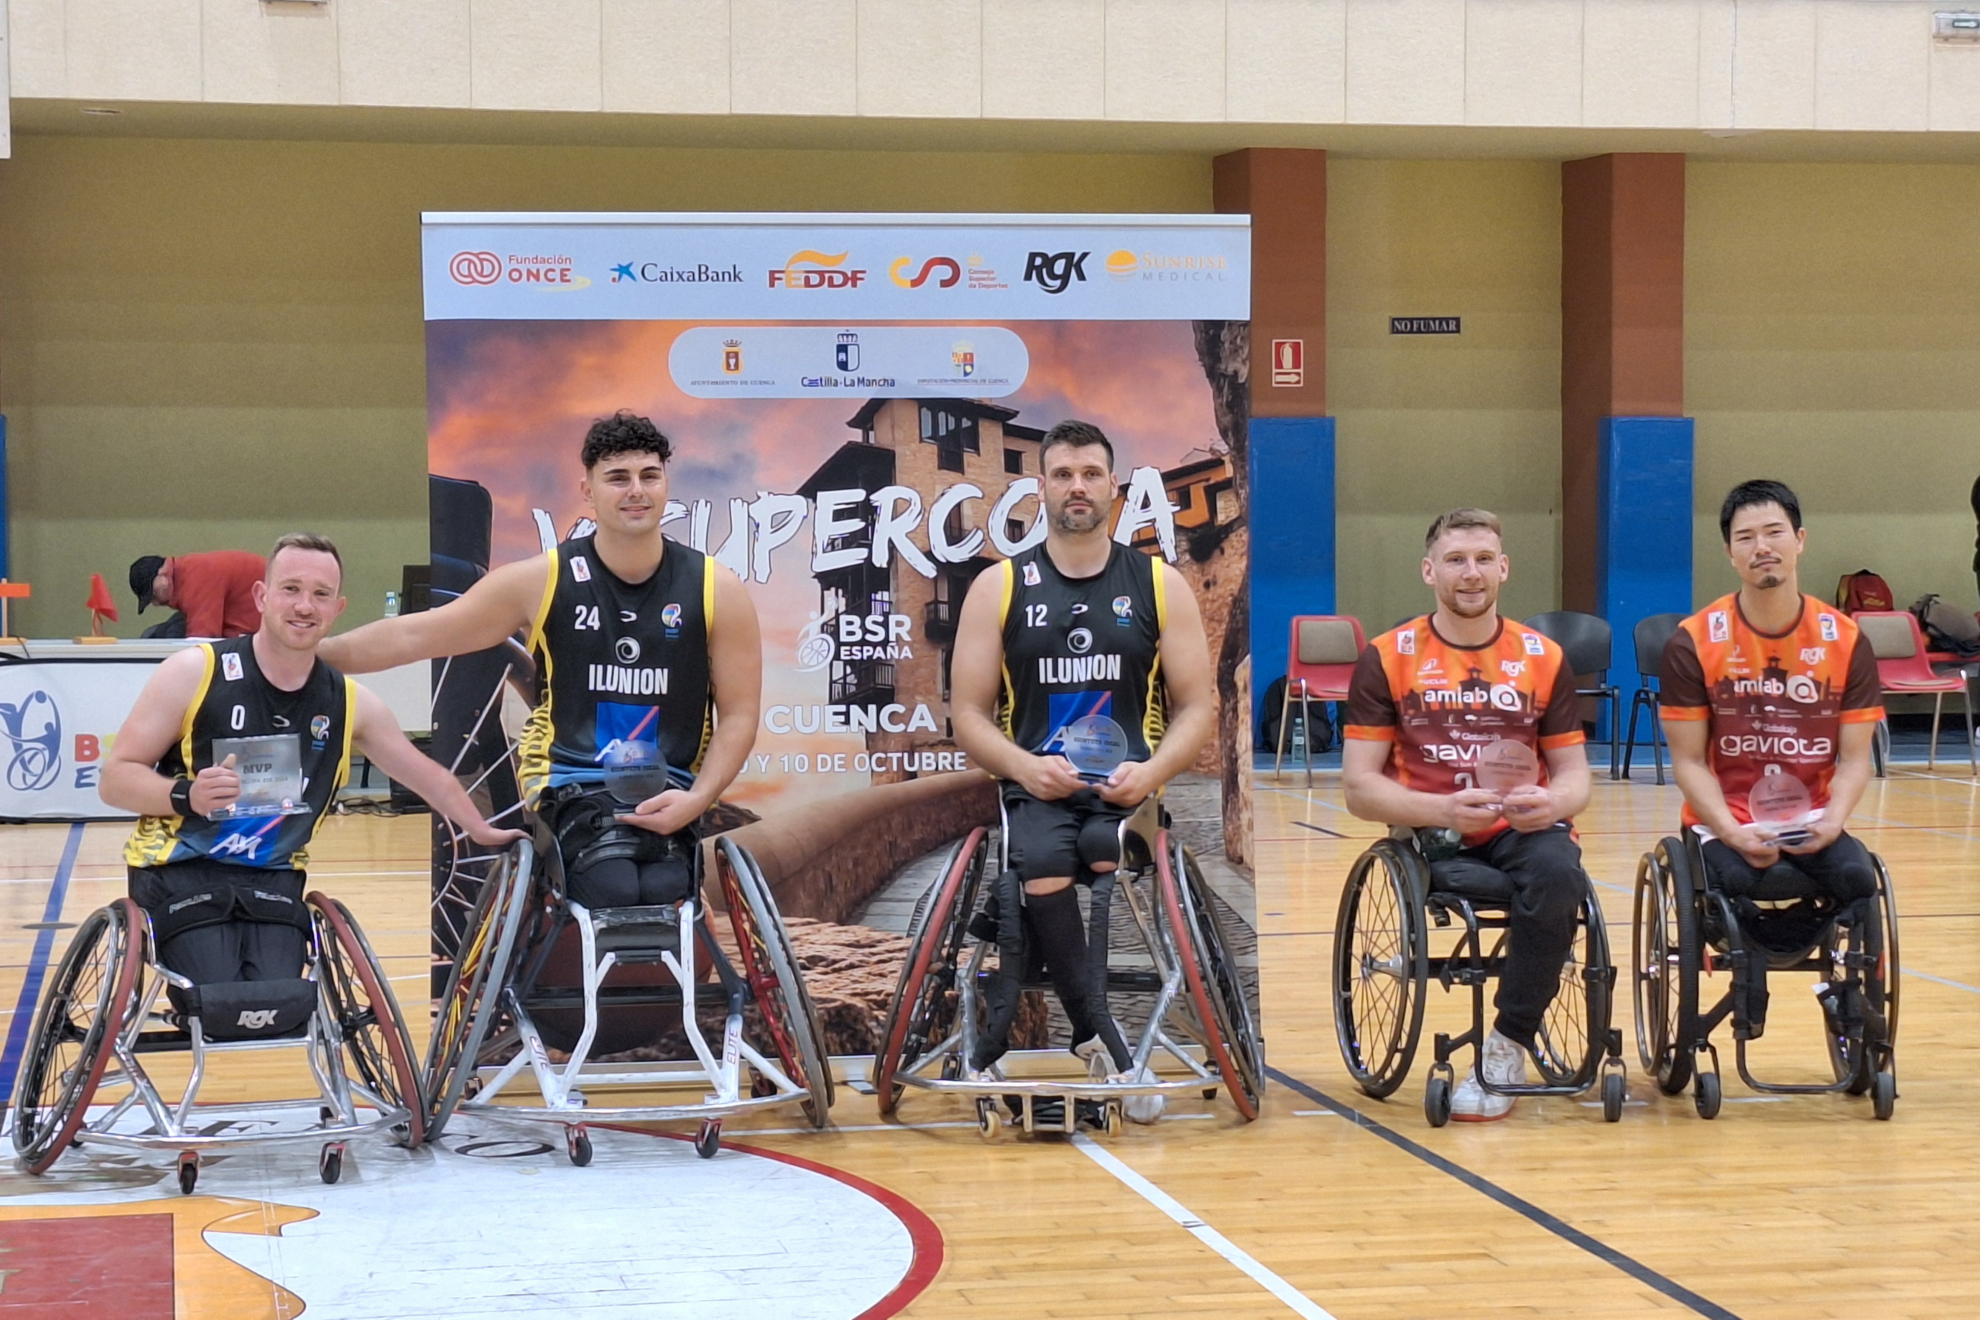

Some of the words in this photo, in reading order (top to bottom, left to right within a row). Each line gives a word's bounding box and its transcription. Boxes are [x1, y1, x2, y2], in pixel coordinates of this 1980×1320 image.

[508, 254, 572, 265] Fundación
[508, 268, 572, 283] ONCE
[640, 263, 744, 283] CaixaBank
[1142, 271, 1226, 282] MEDICAL
[1394, 319, 1411, 332] NO
[1412, 319, 1457, 332] FUMAR
[857, 376, 896, 388] Mancha
[574, 604, 601, 631] 24
[1025, 603, 1048, 628] 12
[838, 614, 912, 643] BSR
[839, 643, 913, 660] ESPAÑA
[588, 664, 669, 695] ILUNION
[1038, 654, 1121, 684] ILUNION
[230, 704, 245, 730] 0
[764, 703, 938, 734] CUENCA
[1719, 734, 1831, 757] gaviota
[243, 763, 273, 775] MVP
[756, 754, 771, 773] Y
[780, 754, 810, 773] 10
[816, 753, 847, 772] DE
[853, 751, 967, 772] OCTUBRE
[726, 1026, 739, 1065] ELITE
